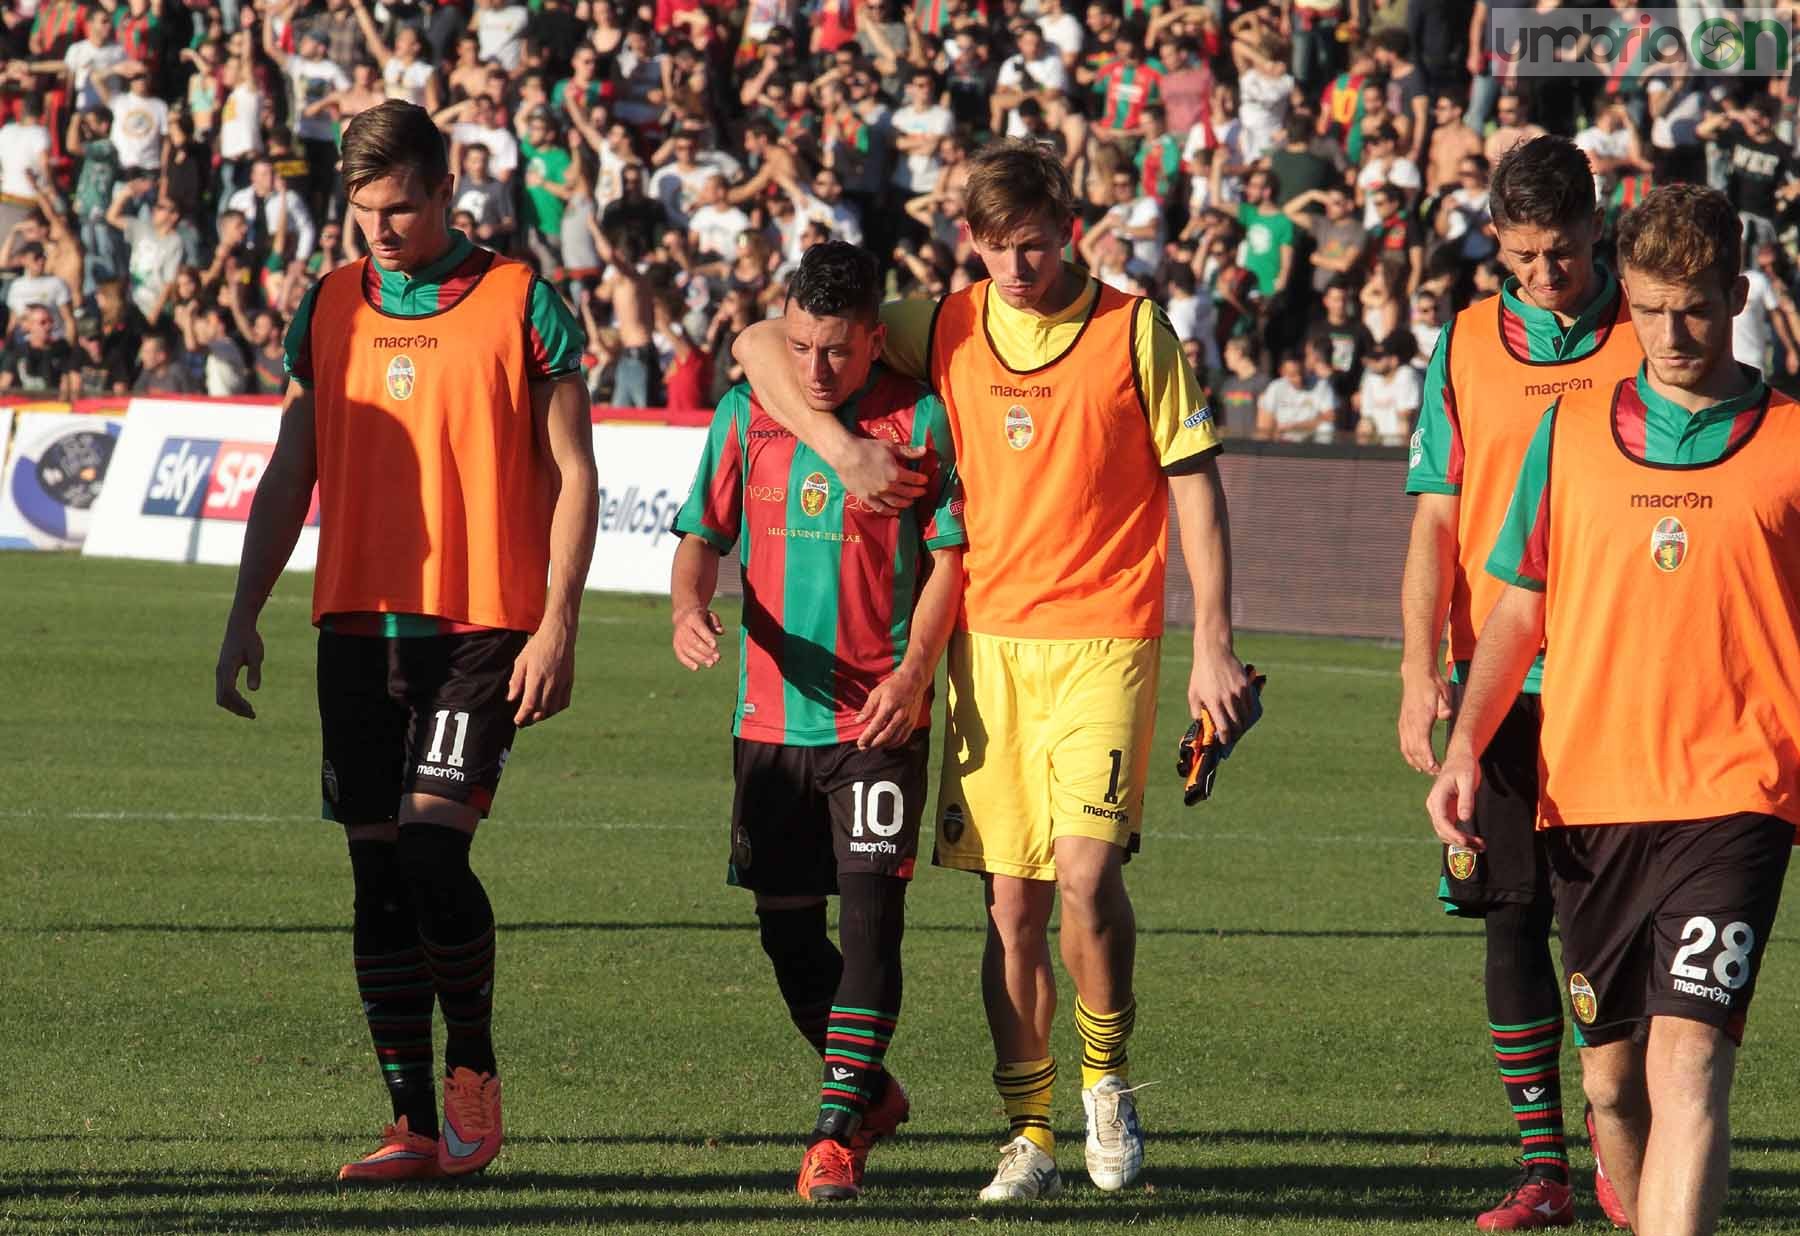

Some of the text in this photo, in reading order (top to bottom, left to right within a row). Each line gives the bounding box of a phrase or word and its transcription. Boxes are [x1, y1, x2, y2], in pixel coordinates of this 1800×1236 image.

[373, 334, 439, 349] macron
[990, 384, 1052, 398] macron
[1524, 377, 1593, 397] macron
[150, 439, 212, 515] sky
[207, 452, 266, 508] SP
[1630, 492, 1713, 509] macron
[426, 709, 470, 768] 11
[416, 764, 465, 782] macron
[1103, 749, 1123, 805] 1
[852, 780, 904, 837] 10
[849, 840, 897, 855] macron
[1669, 915, 1754, 989] 28
[1673, 978, 1730, 1005] macron
